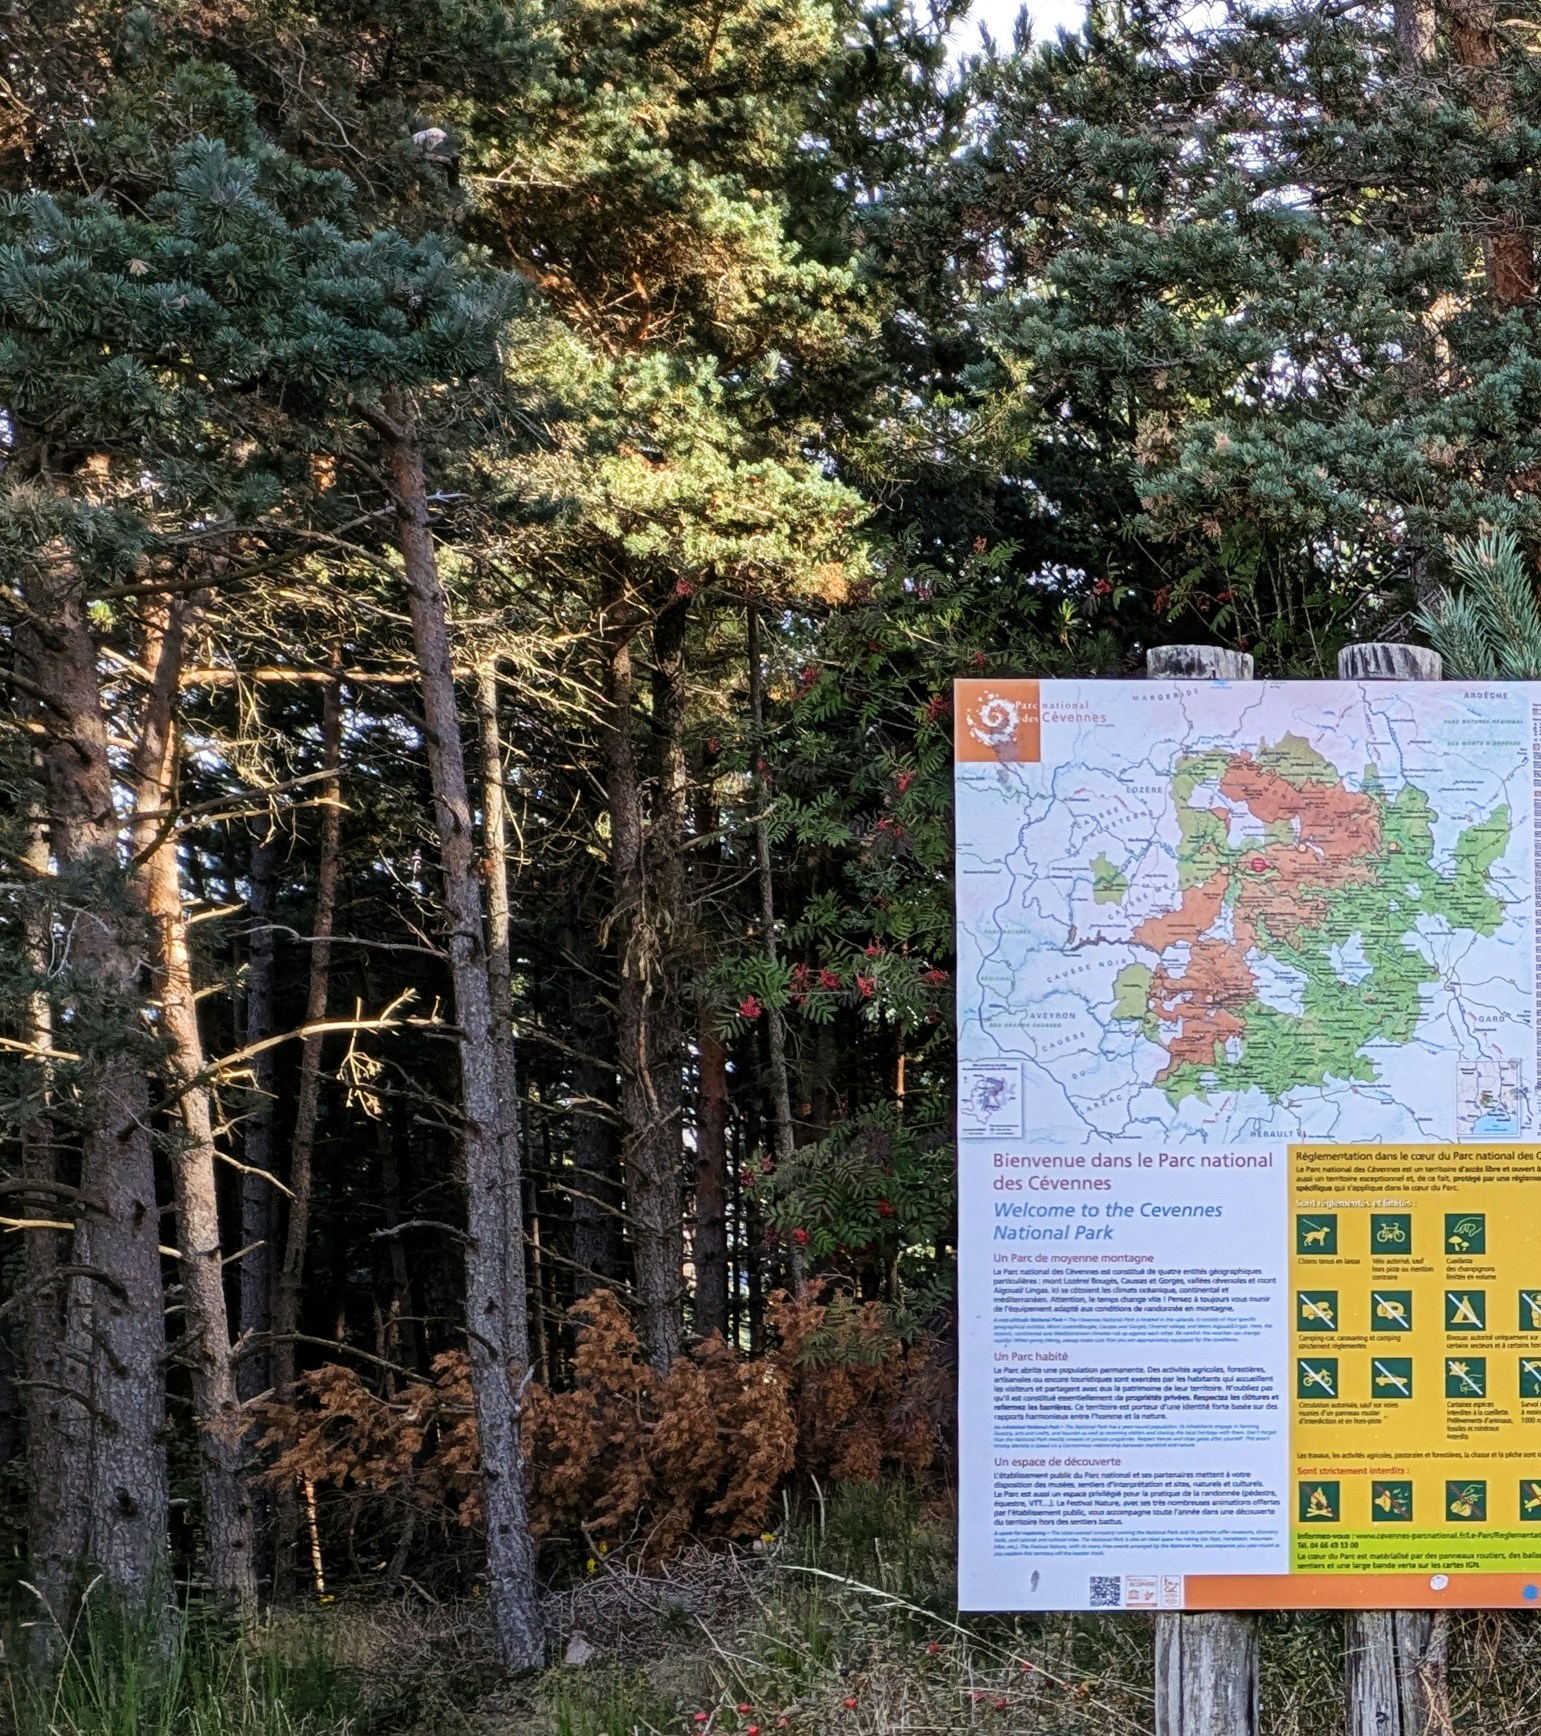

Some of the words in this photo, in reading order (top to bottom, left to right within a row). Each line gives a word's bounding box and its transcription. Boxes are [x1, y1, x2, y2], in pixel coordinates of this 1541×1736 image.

[1015, 700, 1038, 710] Parc
[1042, 700, 1089, 710] national
[1021, 714, 1039, 723] des
[1042, 712, 1107, 723] Cévennes
[1029, 1011, 1076, 1020] AVEYRON
[1477, 1015, 1506, 1024] GARD
[993, 1152, 1085, 1167] Bienvenue
[1091, 1152, 1132, 1167] dans
[1138, 1152, 1153, 1167] le
[1158, 1153, 1195, 1167] Parc
[1200, 1152, 1272, 1167] national
[1295, 1151, 1372, 1162] Réglementation
[1373, 1151, 1397, 1160] dans
[1398, 1151, 1408, 1160] le
[1436, 1151, 1450, 1160] du
[1451, 1151, 1473, 1160] Parc
[1475, 1151, 1515, 1160] national
[1515, 1151, 1533, 1160] des
[993, 1175, 1022, 1190] des
[1028, 1175, 1111, 1190] Cévennes
[994, 1202, 1075, 1217] Welcome
[1081, 1203, 1099, 1217] to
[1105, 1201, 1134, 1217] the
[1140, 1202, 1222, 1217] Cevennes
[993, 1224, 1070, 1240] National
[1074, 1224, 1113, 1239] Park
[993, 1253, 1008, 1262] Un
[1010, 1253, 1033, 1262] Parc
[1034, 1253, 1048, 1262] de
[1050, 1255, 1098, 1264] moyenne
[1100, 1254, 1154, 1264] montagne
[993, 1352, 1009, 1361] Un
[1011, 1351, 1033, 1361] Parc
[1035, 1351, 1068, 1361] habité
[993, 1457, 1009, 1466] Un
[1011, 1459, 1046, 1468] espace
[1048, 1456, 1062, 1466] de
[1063, 1457, 1121, 1466] découverte
